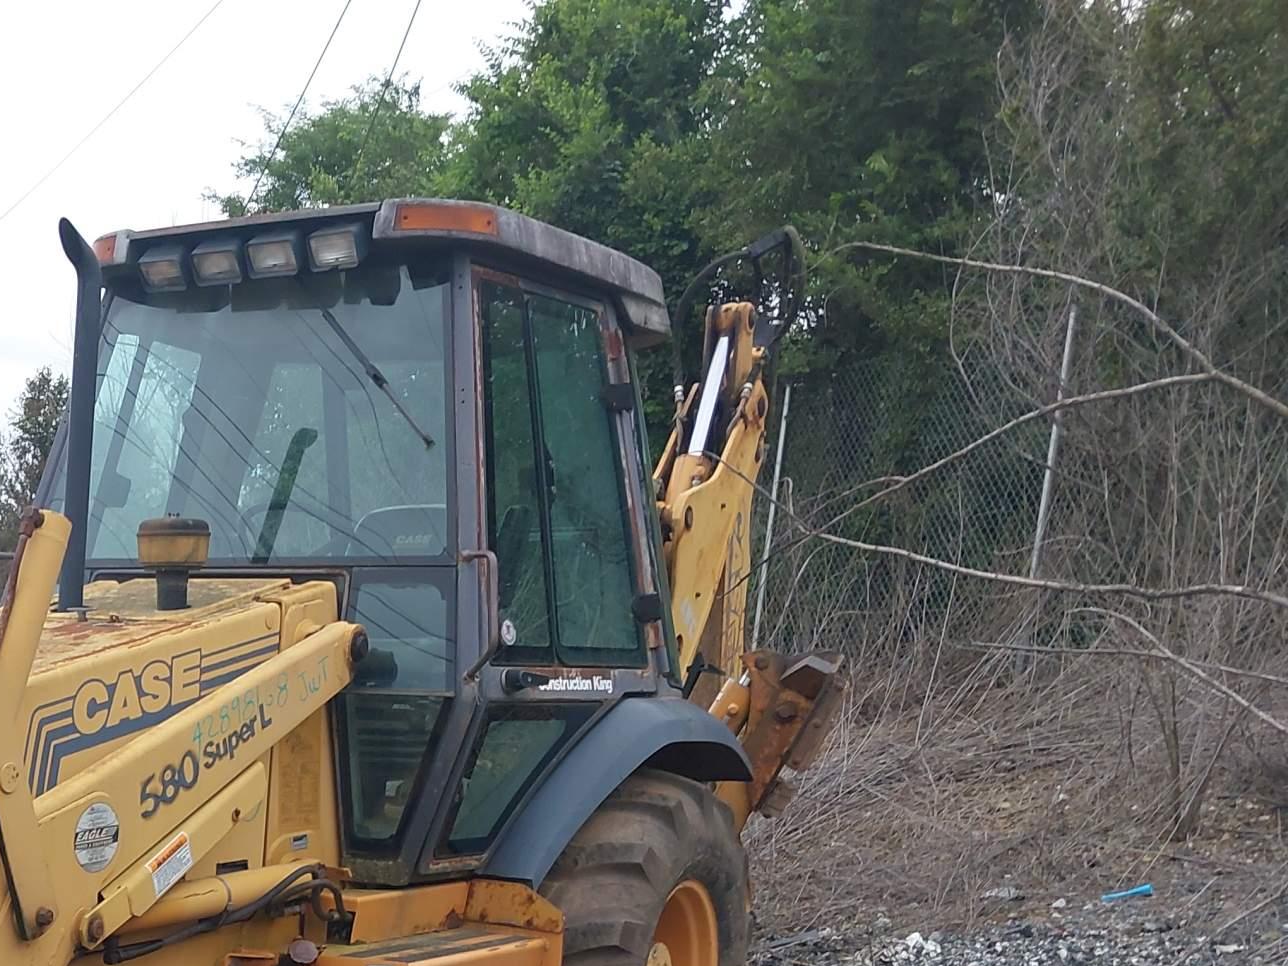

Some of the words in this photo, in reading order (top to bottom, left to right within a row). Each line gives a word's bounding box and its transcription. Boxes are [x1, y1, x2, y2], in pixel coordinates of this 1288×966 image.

[73, 648, 201, 735] CASE
[539, 676, 592, 691] nstruction
[593, 676, 613, 693] King
[140, 750, 199, 818] 580
[203, 715, 257, 769] Super
[259, 703, 272, 730] L
[77, 828, 108, 842] EAGLE
